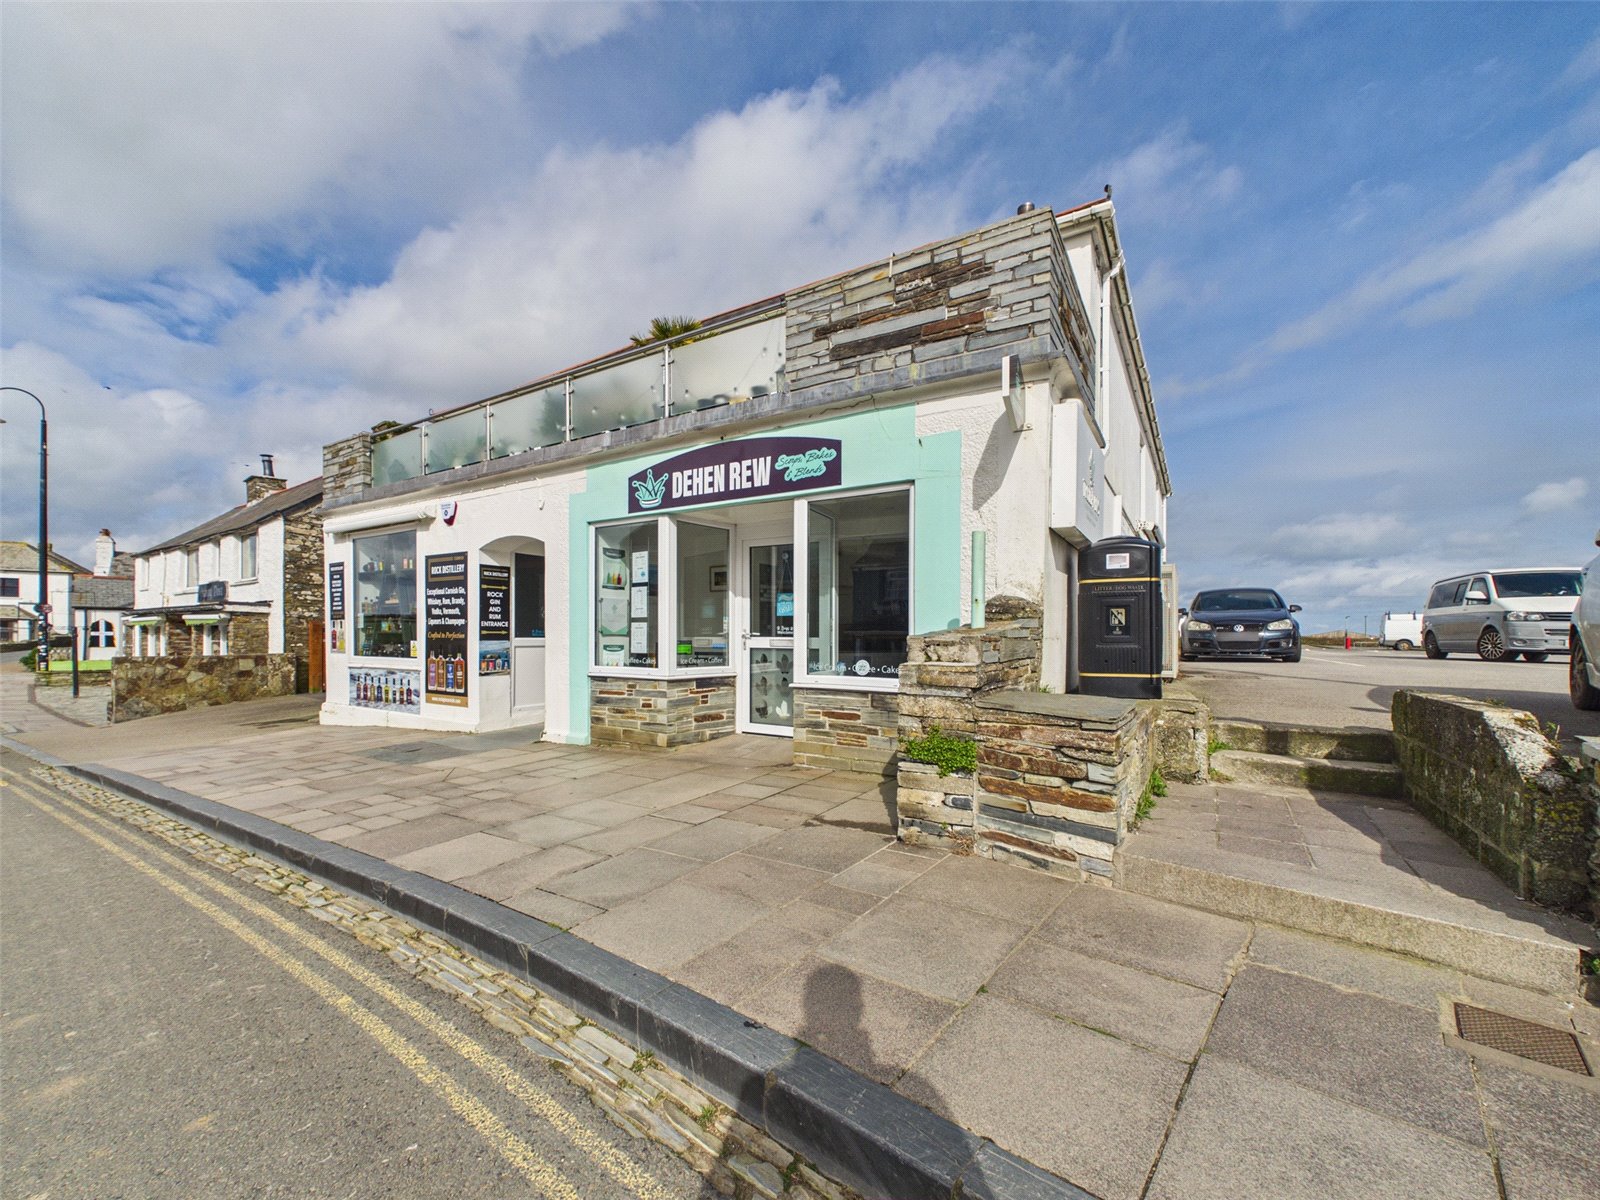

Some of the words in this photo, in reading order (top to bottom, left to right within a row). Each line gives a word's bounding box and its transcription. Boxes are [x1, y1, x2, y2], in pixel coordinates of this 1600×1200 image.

[806, 450, 834, 463] Bakes
[794, 464, 824, 478] Blends
[672, 463, 725, 499] DEHEN
[729, 456, 771, 490] REW
[431, 565, 441, 575] ROCK
[442, 563, 465, 574] DISTILLERY
[689, 657, 705, 665] Cream
[708, 656, 723, 664] Coffee
[881, 665, 900, 674] Cake
